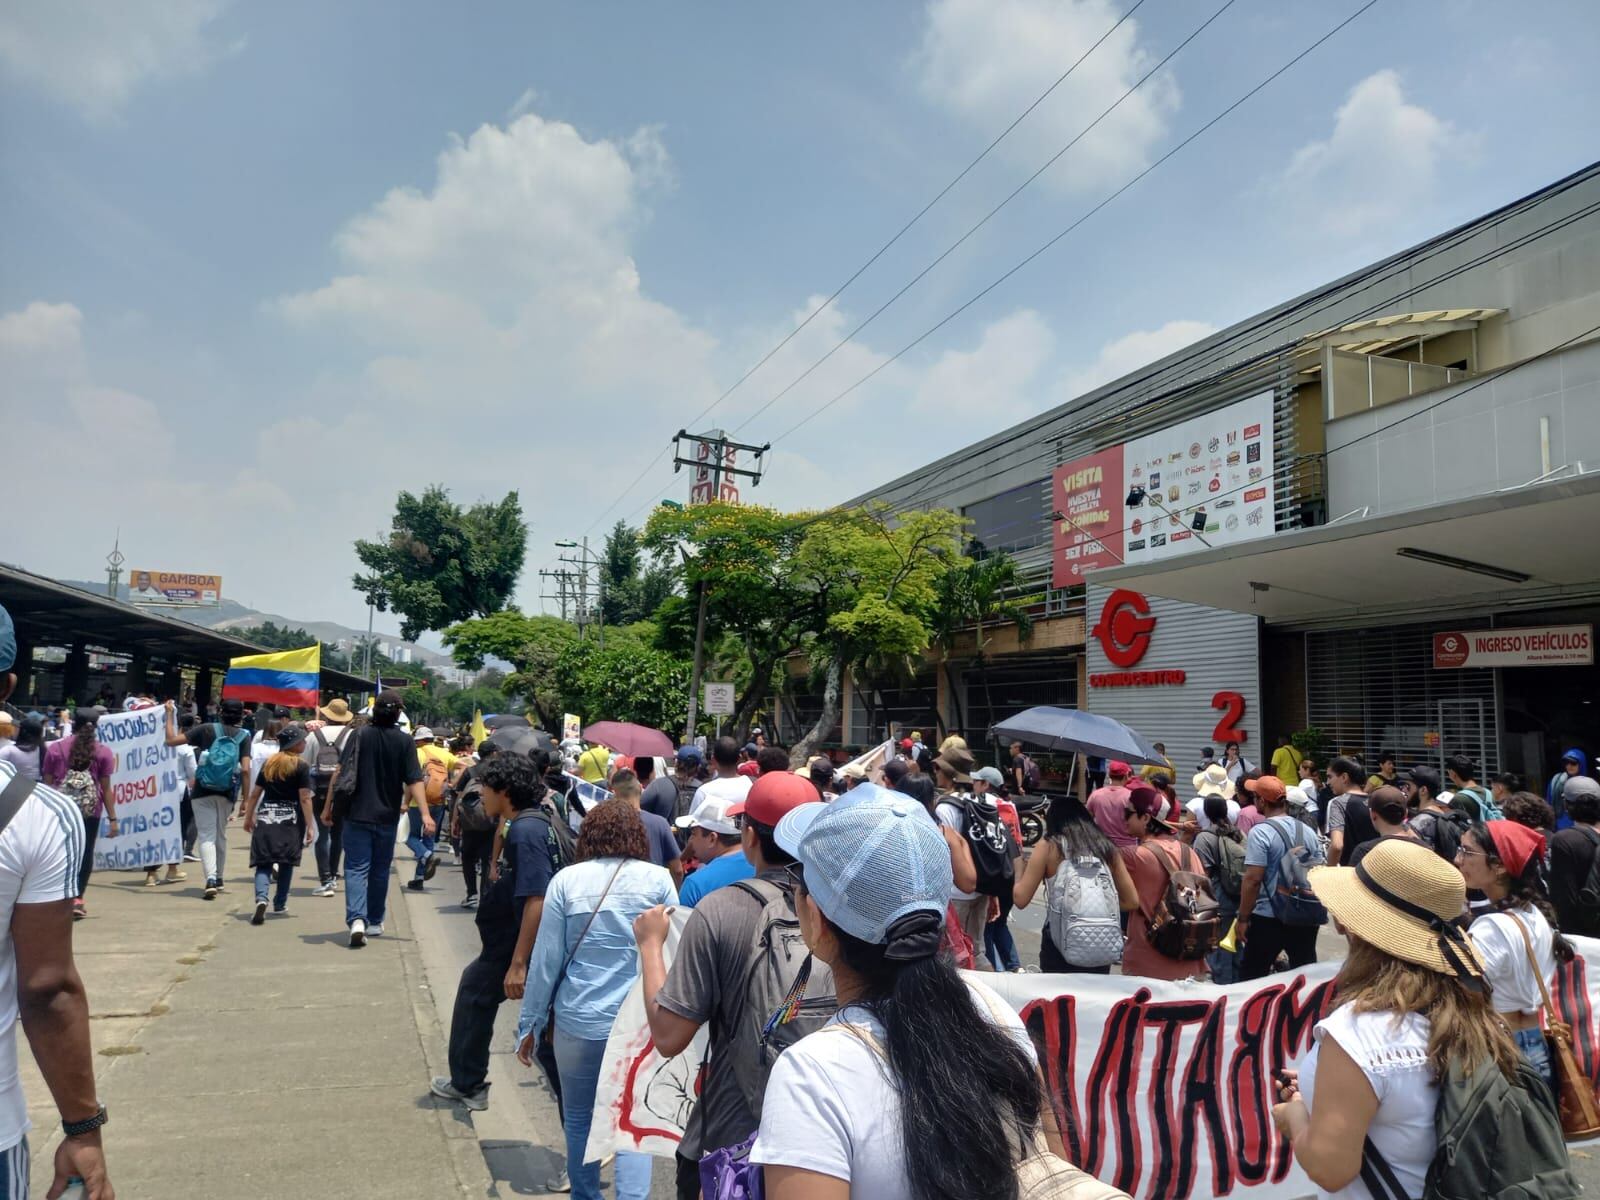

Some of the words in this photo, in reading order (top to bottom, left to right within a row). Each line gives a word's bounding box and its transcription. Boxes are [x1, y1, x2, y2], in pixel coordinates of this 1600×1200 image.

[1063, 466, 1104, 493] VISITA
[1072, 510, 1111, 527] COMIDAS
[159, 573, 216, 587] GAMBOA
[1475, 636, 1522, 653] INGRESO
[1524, 631, 1589, 651] VEHÍCULOS
[1089, 669, 1186, 688] COSMOCENTRO
[1211, 690, 1248, 744] 2
